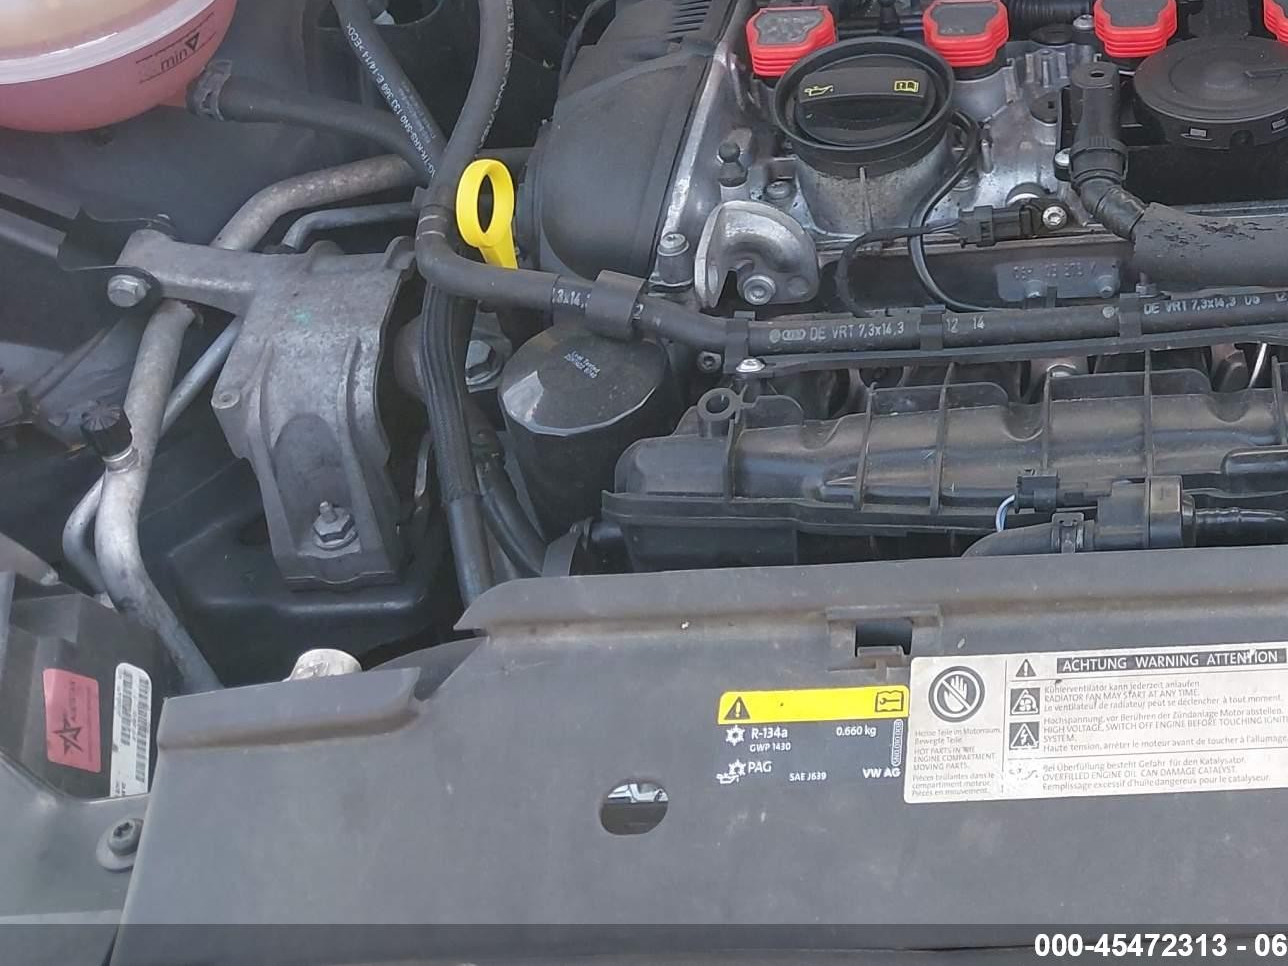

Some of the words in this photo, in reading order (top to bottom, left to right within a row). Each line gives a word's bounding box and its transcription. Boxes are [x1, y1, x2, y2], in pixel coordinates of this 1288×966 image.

[161, 48, 188, 71] min
[1143, 303, 1160, 314] DE
[1165, 301, 1187, 312] VRT
[810, 327, 827, 341] DE
[831, 326, 854, 339] VRT
[946, 318, 959, 333] 12
[972, 316, 985, 330] 14
[1062, 657, 1127, 672] ACHTUNG
[1135, 653, 1199, 668] WARNING
[1206, 650, 1278, 665] ATTENTION
[1086, 693, 1101, 701] FAN
[1123, 691, 1145, 699] START
[1055, 701, 1097, 710] ventilateur
[1147, 700, 1165, 709] peut
[1105, 723, 1136, 731] SWITCH
[1155, 719, 1186, 729] ENGINE
[1188, 718, 1217, 727] BEFORE
[1219, 717, 1262, 726] TOUCHING
[751, 727, 788, 739] R-134a
[836, 726, 862, 736] 0.660
[864, 726, 877, 737] kg
[773, 743, 791, 751] 1430
[1208, 737, 1238, 745] toucher
[748, 761, 772, 773] PAG
[1138, 760, 1165, 768] Gefahr
[790, 772, 805, 781] SAE
[807, 772, 827, 780] J639
[862, 769, 881, 778] VW
[884, 768, 901, 778] AG
[1042, 771, 1089, 781] OVERFILLED
[1092, 771, 1121, 779] ENGINE
[1124, 770, 1136, 778] OIL
[1141, 769, 1158, 777] CAN
[1160, 767, 1196, 776] DAMAGE
[1094, 780, 1124, 788] excessif
[1199, 777, 1217, 786] pour
